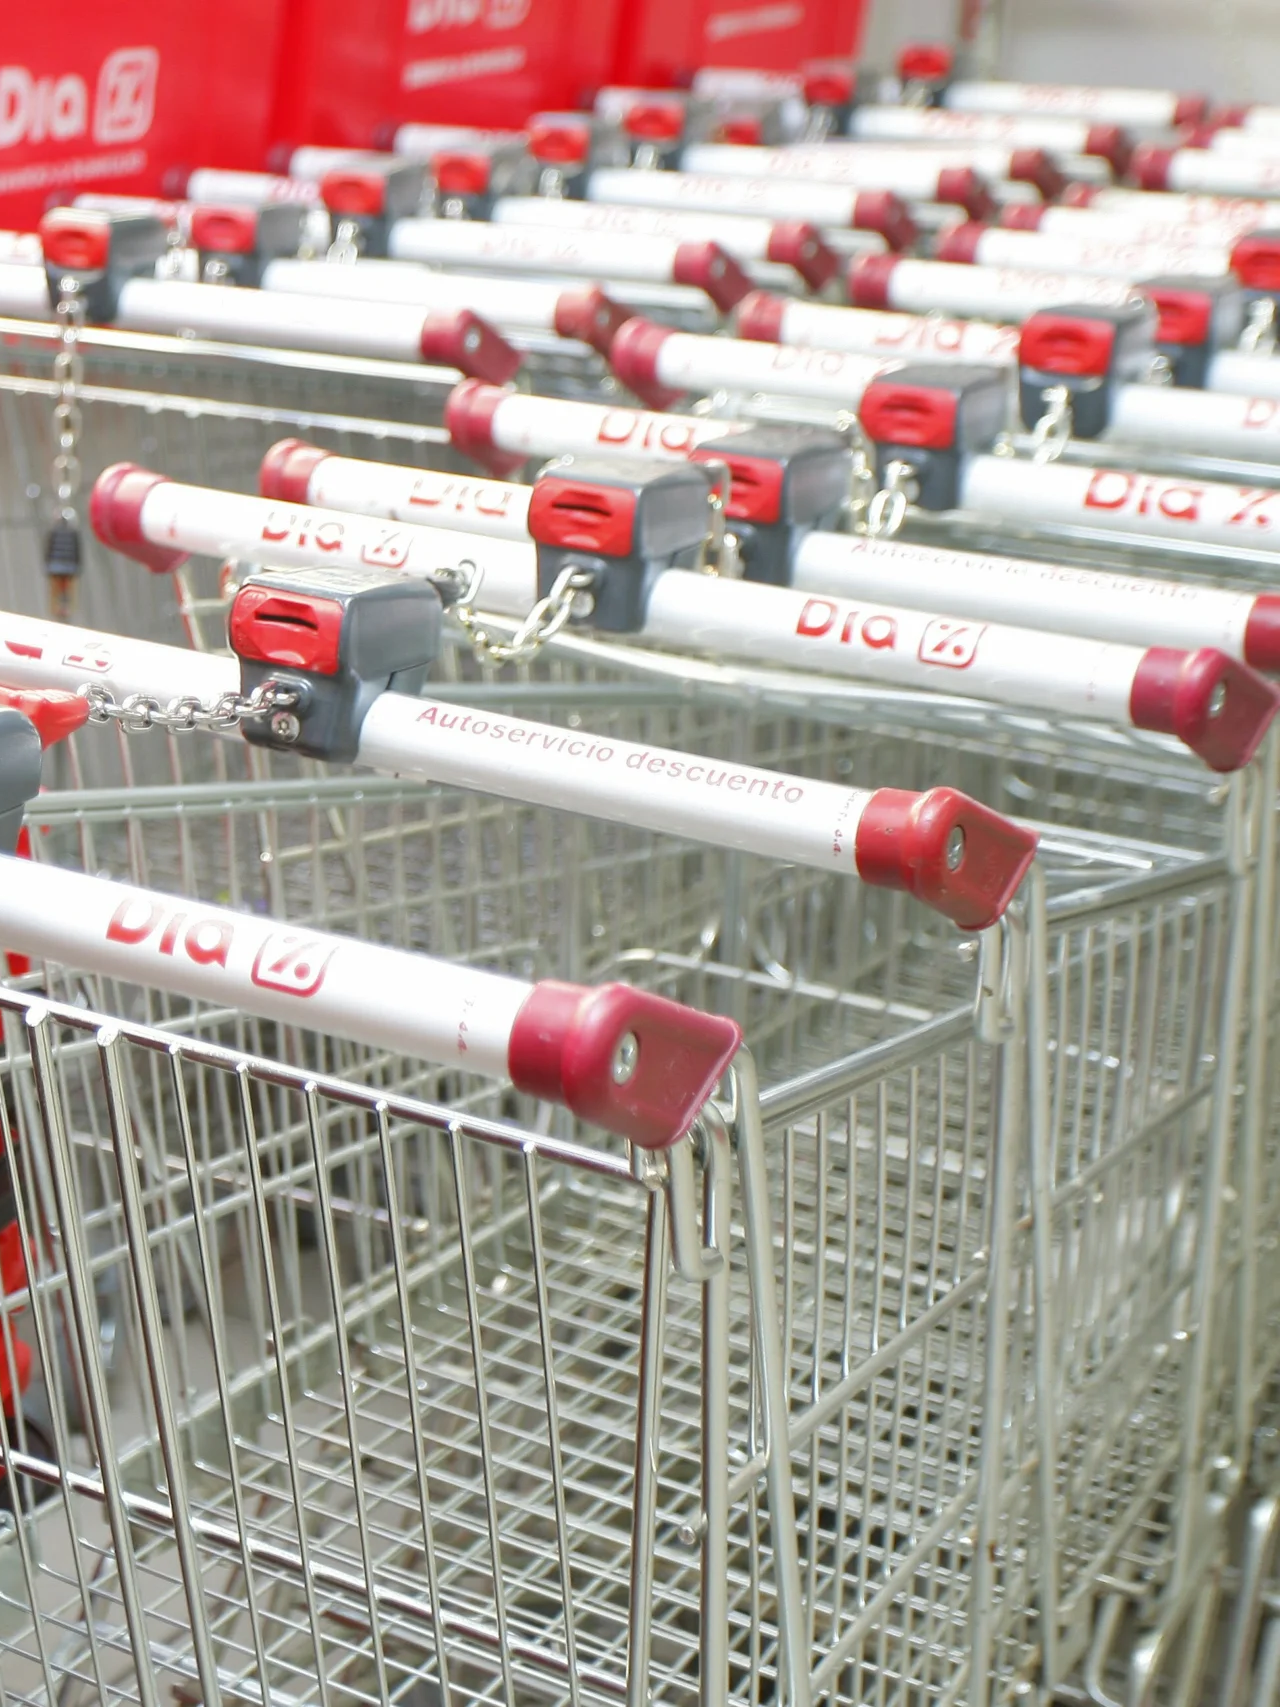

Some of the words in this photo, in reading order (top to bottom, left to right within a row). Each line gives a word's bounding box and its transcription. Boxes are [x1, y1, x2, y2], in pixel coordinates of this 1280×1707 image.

[1083, 468, 1205, 521] Dia
[796, 598, 898, 652] Dia
[416, 705, 615, 763] Autoservicio
[625, 750, 805, 804] descuento
[105, 898, 235, 970] Dia
